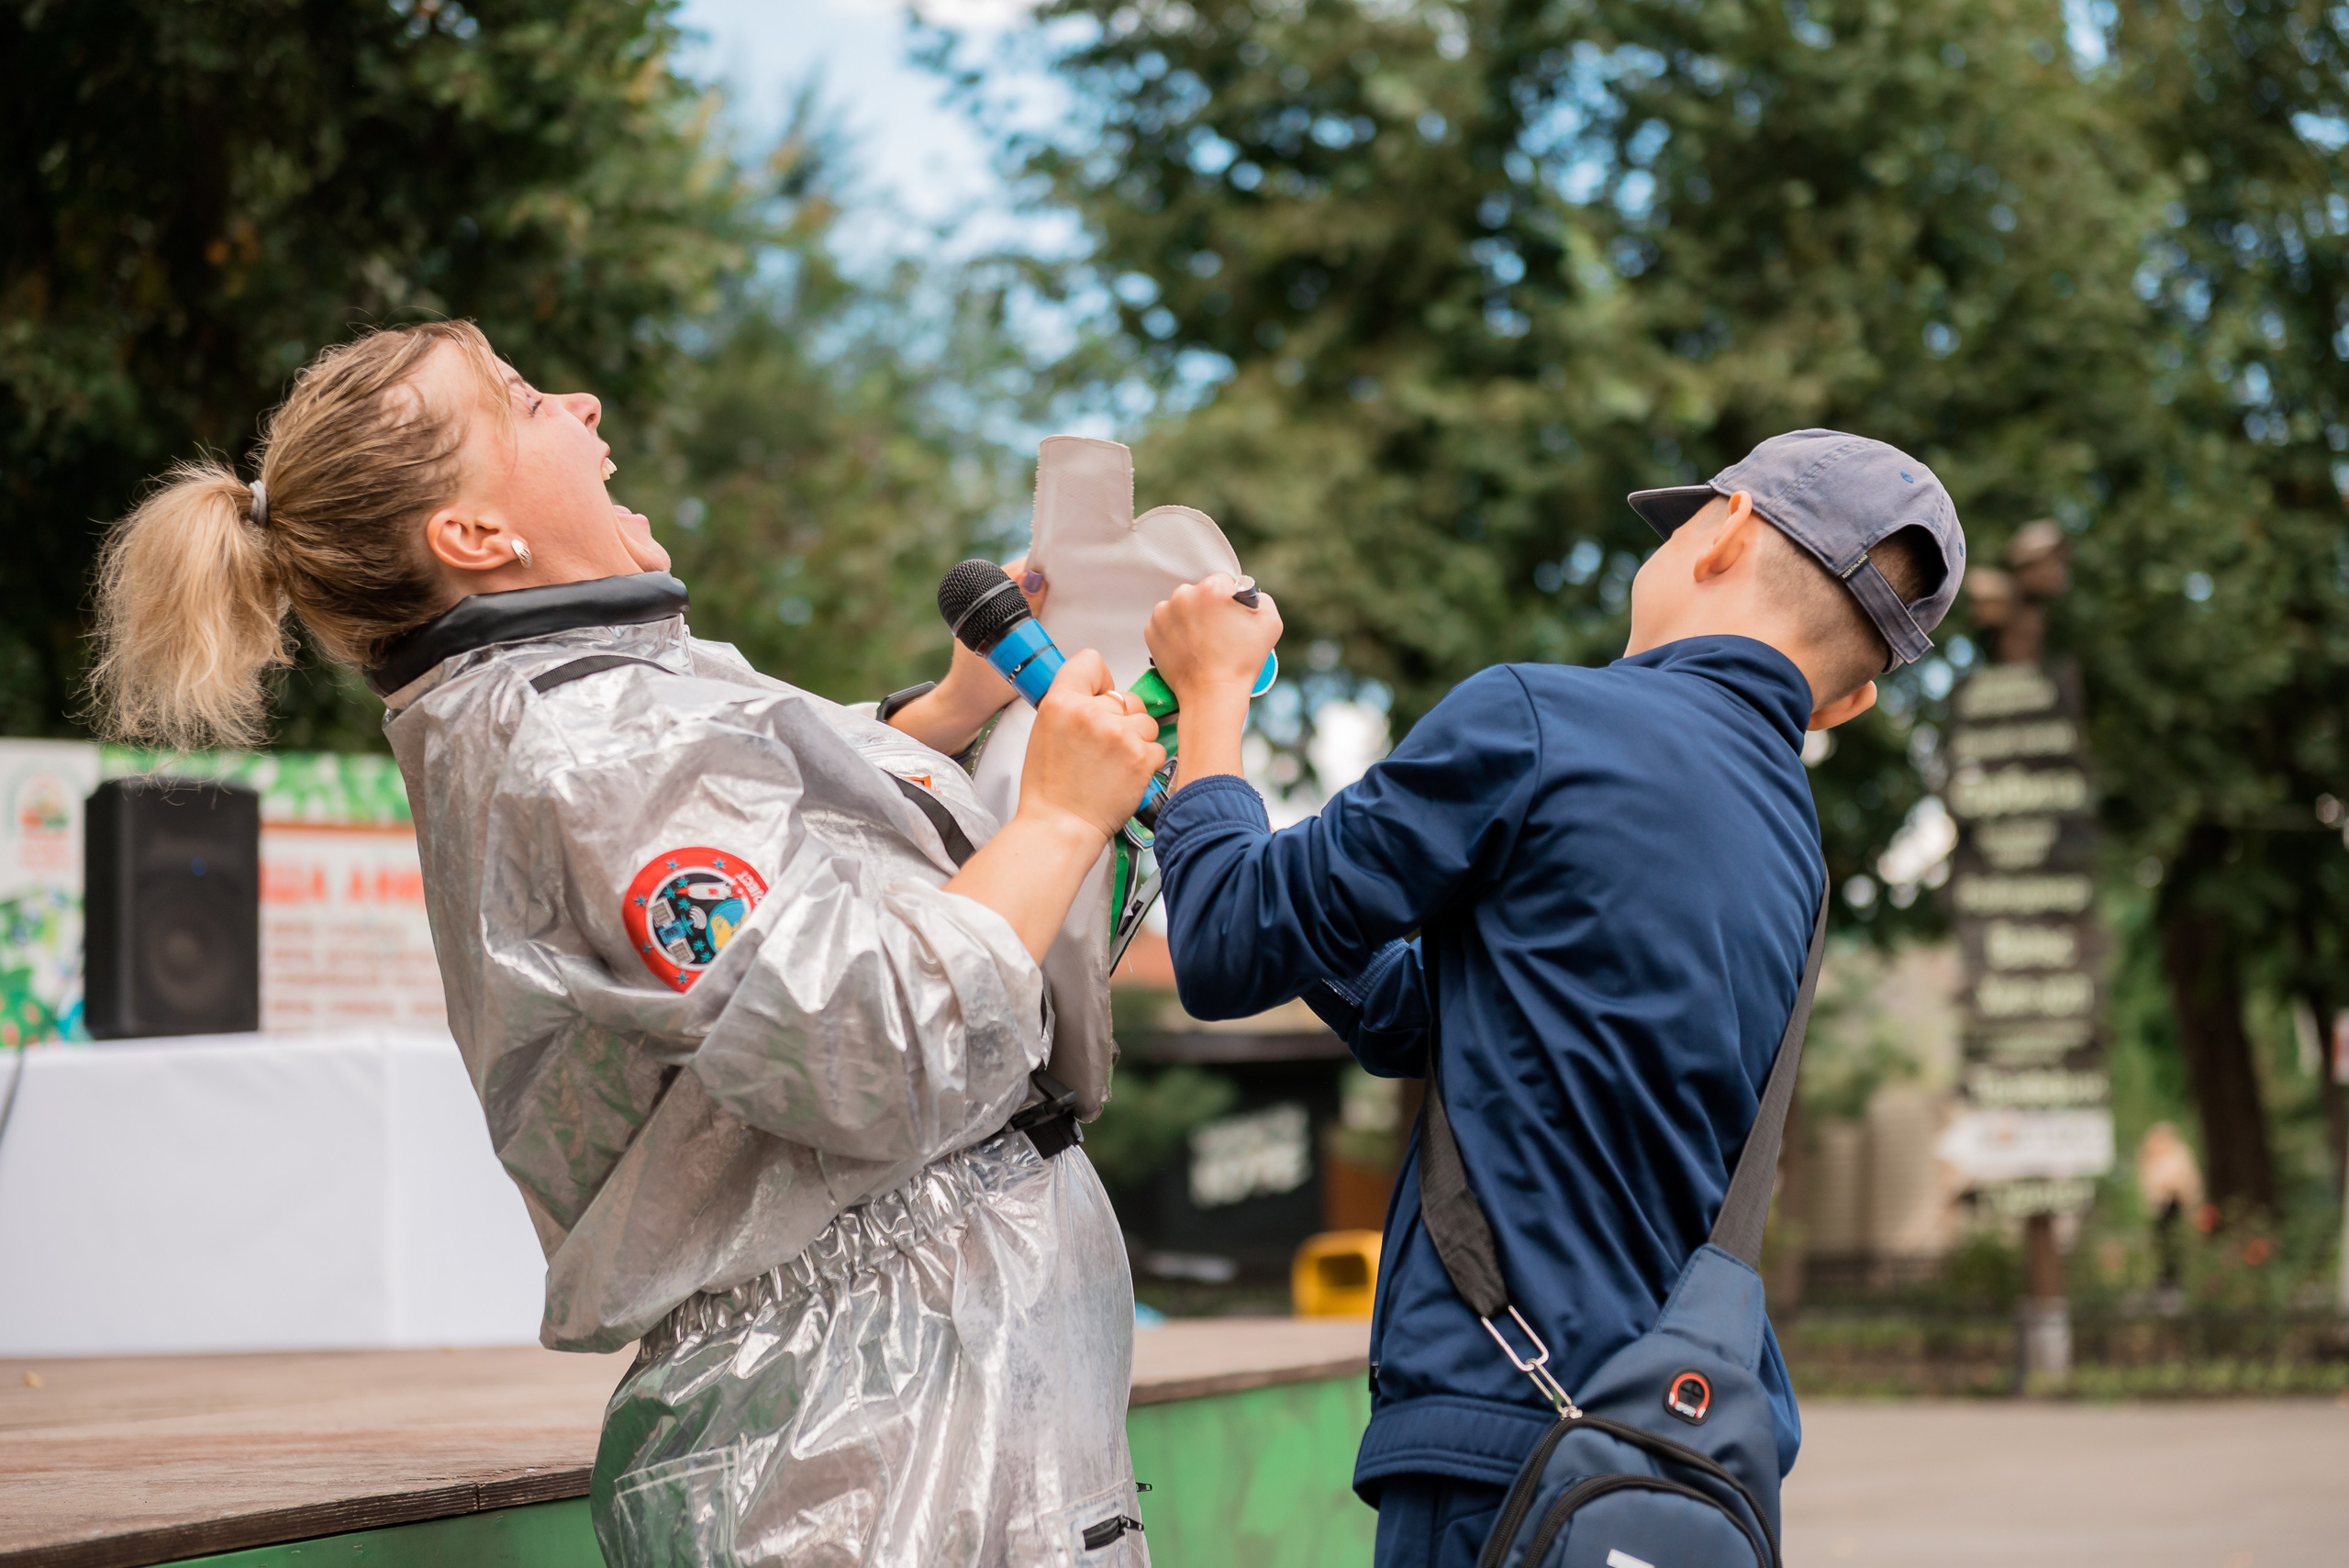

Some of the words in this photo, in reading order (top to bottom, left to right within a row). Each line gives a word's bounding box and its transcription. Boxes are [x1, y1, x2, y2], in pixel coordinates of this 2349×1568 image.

[1841, 554, 1868, 579] NORTHLAND
[735, 870, 765, 905] OJECT
[1674, 1401, 1698, 1418] SPORT
